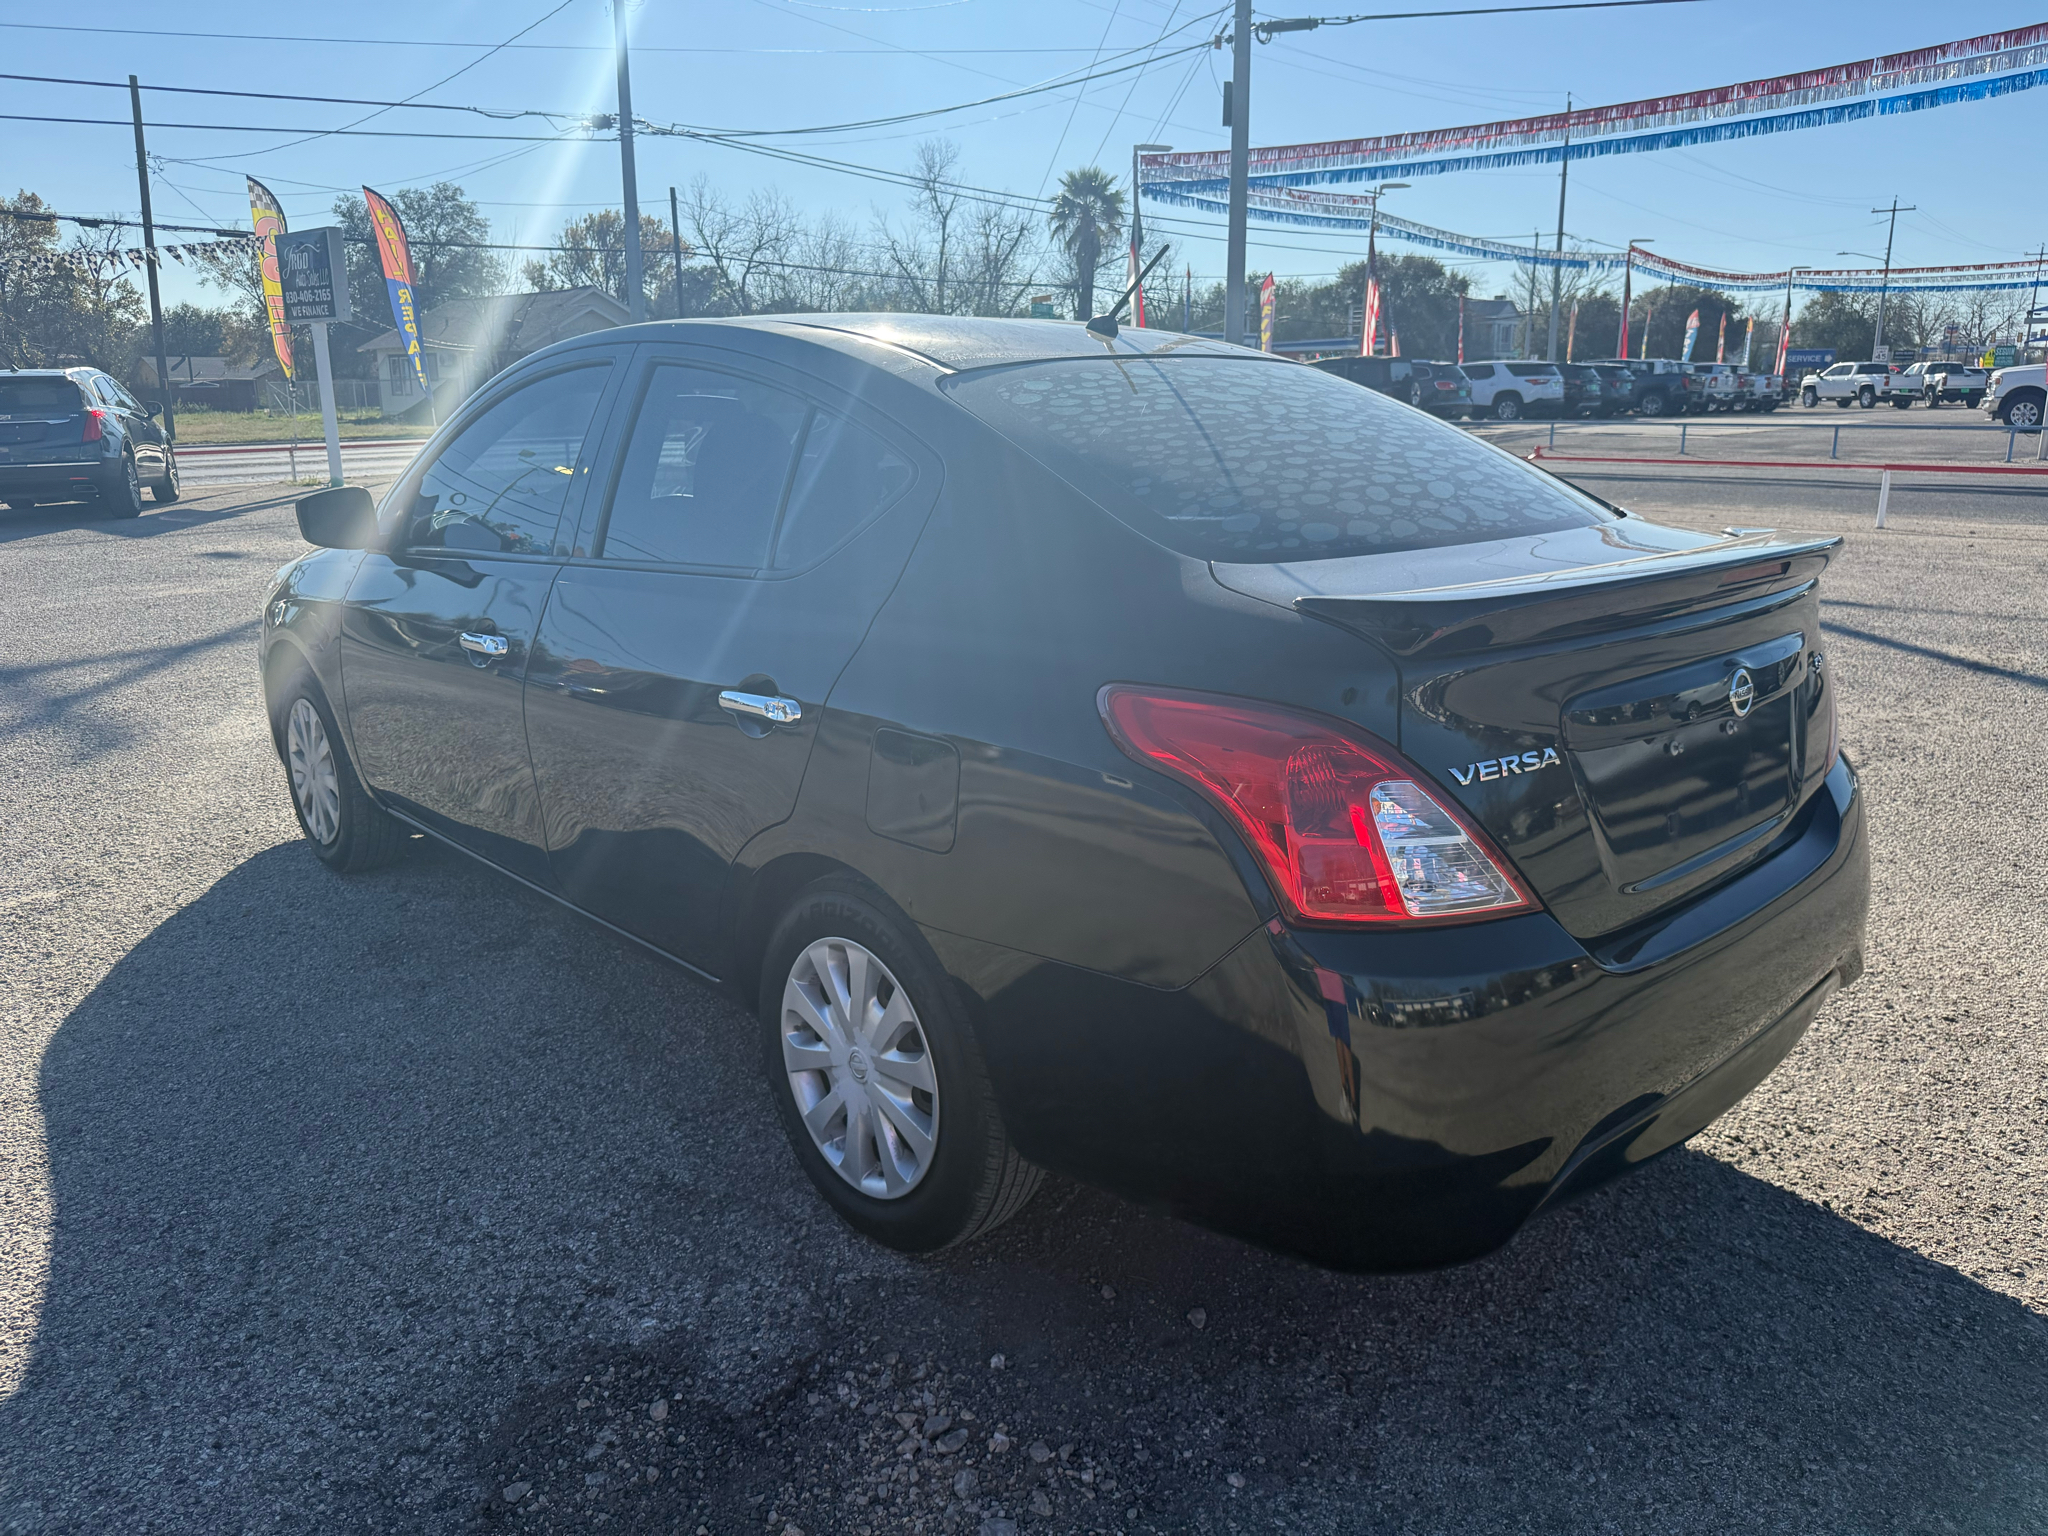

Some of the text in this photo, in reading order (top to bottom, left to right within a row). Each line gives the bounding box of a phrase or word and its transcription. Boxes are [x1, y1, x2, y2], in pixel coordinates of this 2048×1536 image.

[285, 288, 332, 304] 830-406-2165
[291, 304, 330, 317] WE FINANCE
[1787, 354, 1822, 363] SERVICE
[1447, 747, 1561, 786] VERSA
